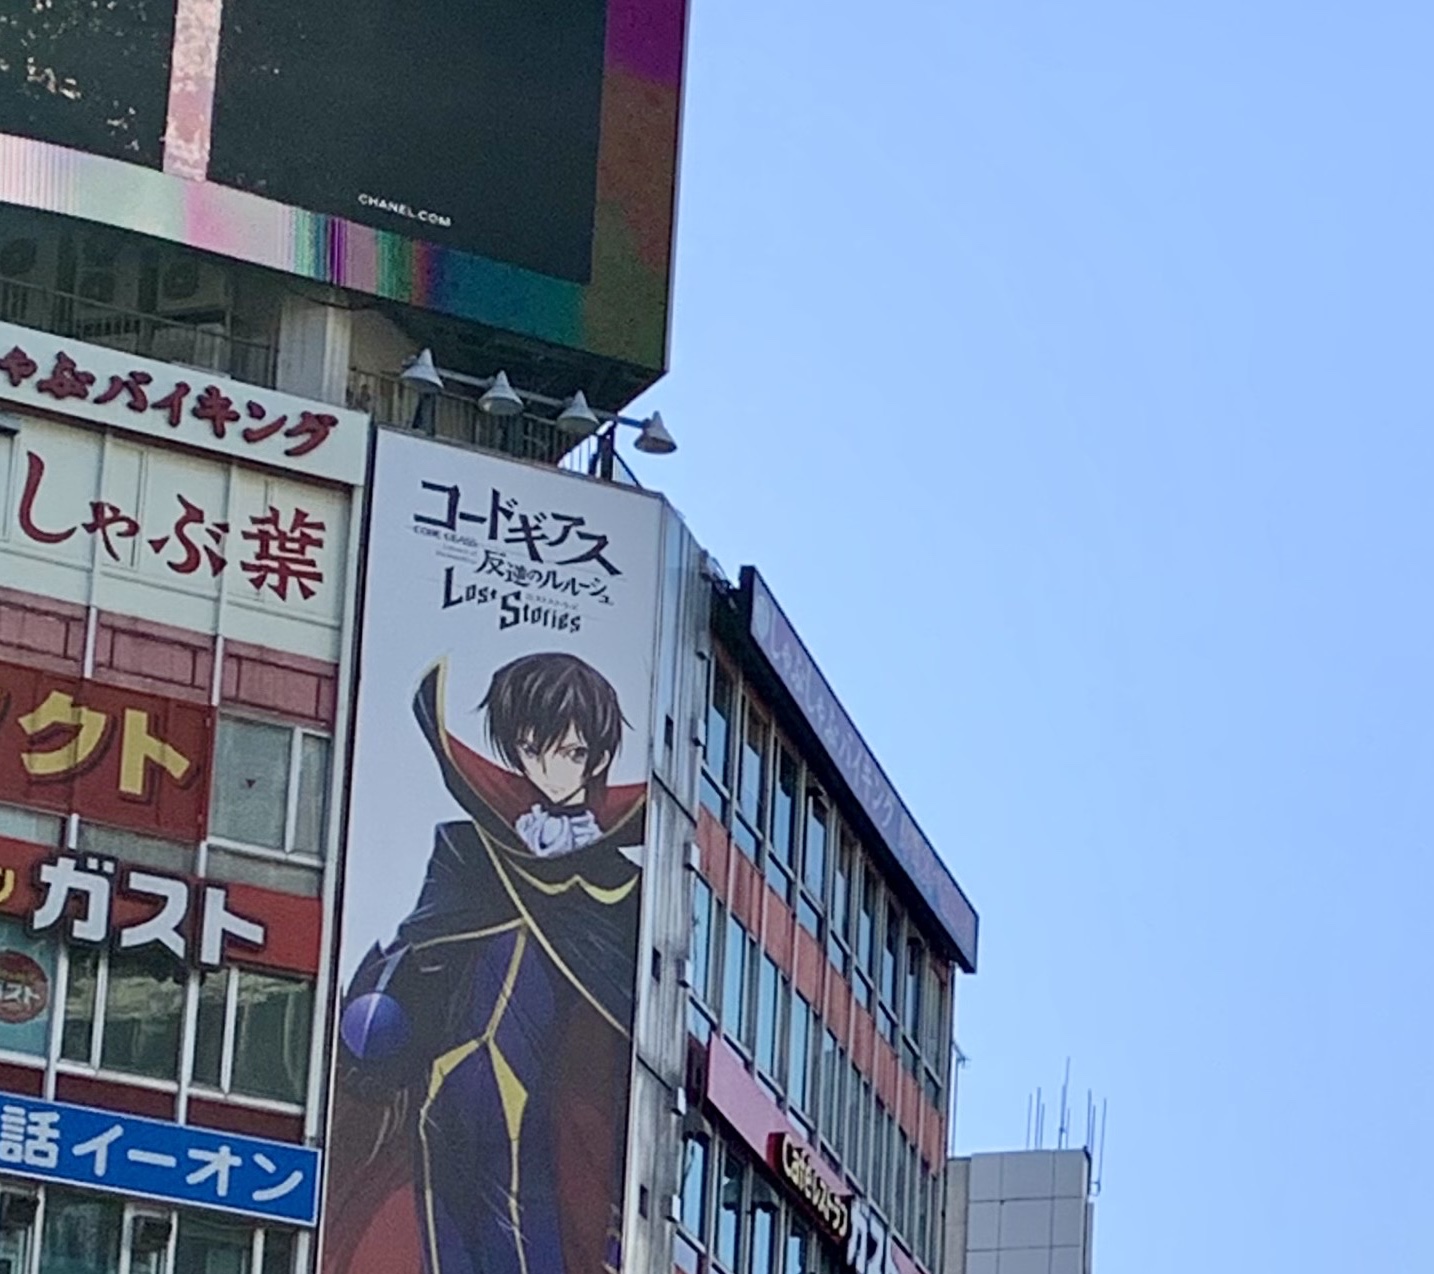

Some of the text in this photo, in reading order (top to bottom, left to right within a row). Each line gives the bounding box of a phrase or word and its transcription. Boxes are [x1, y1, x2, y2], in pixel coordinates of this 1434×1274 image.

[358, 193, 452, 227] CHANEL.COM
[19, 451, 326, 601] しゃぶ葉
[413, 479, 623, 576] コードギアス
[442, 566, 497, 609] Lost
[476, 548, 615, 606] 反逆のルルーシュ
[499, 590, 581, 634] Stories
